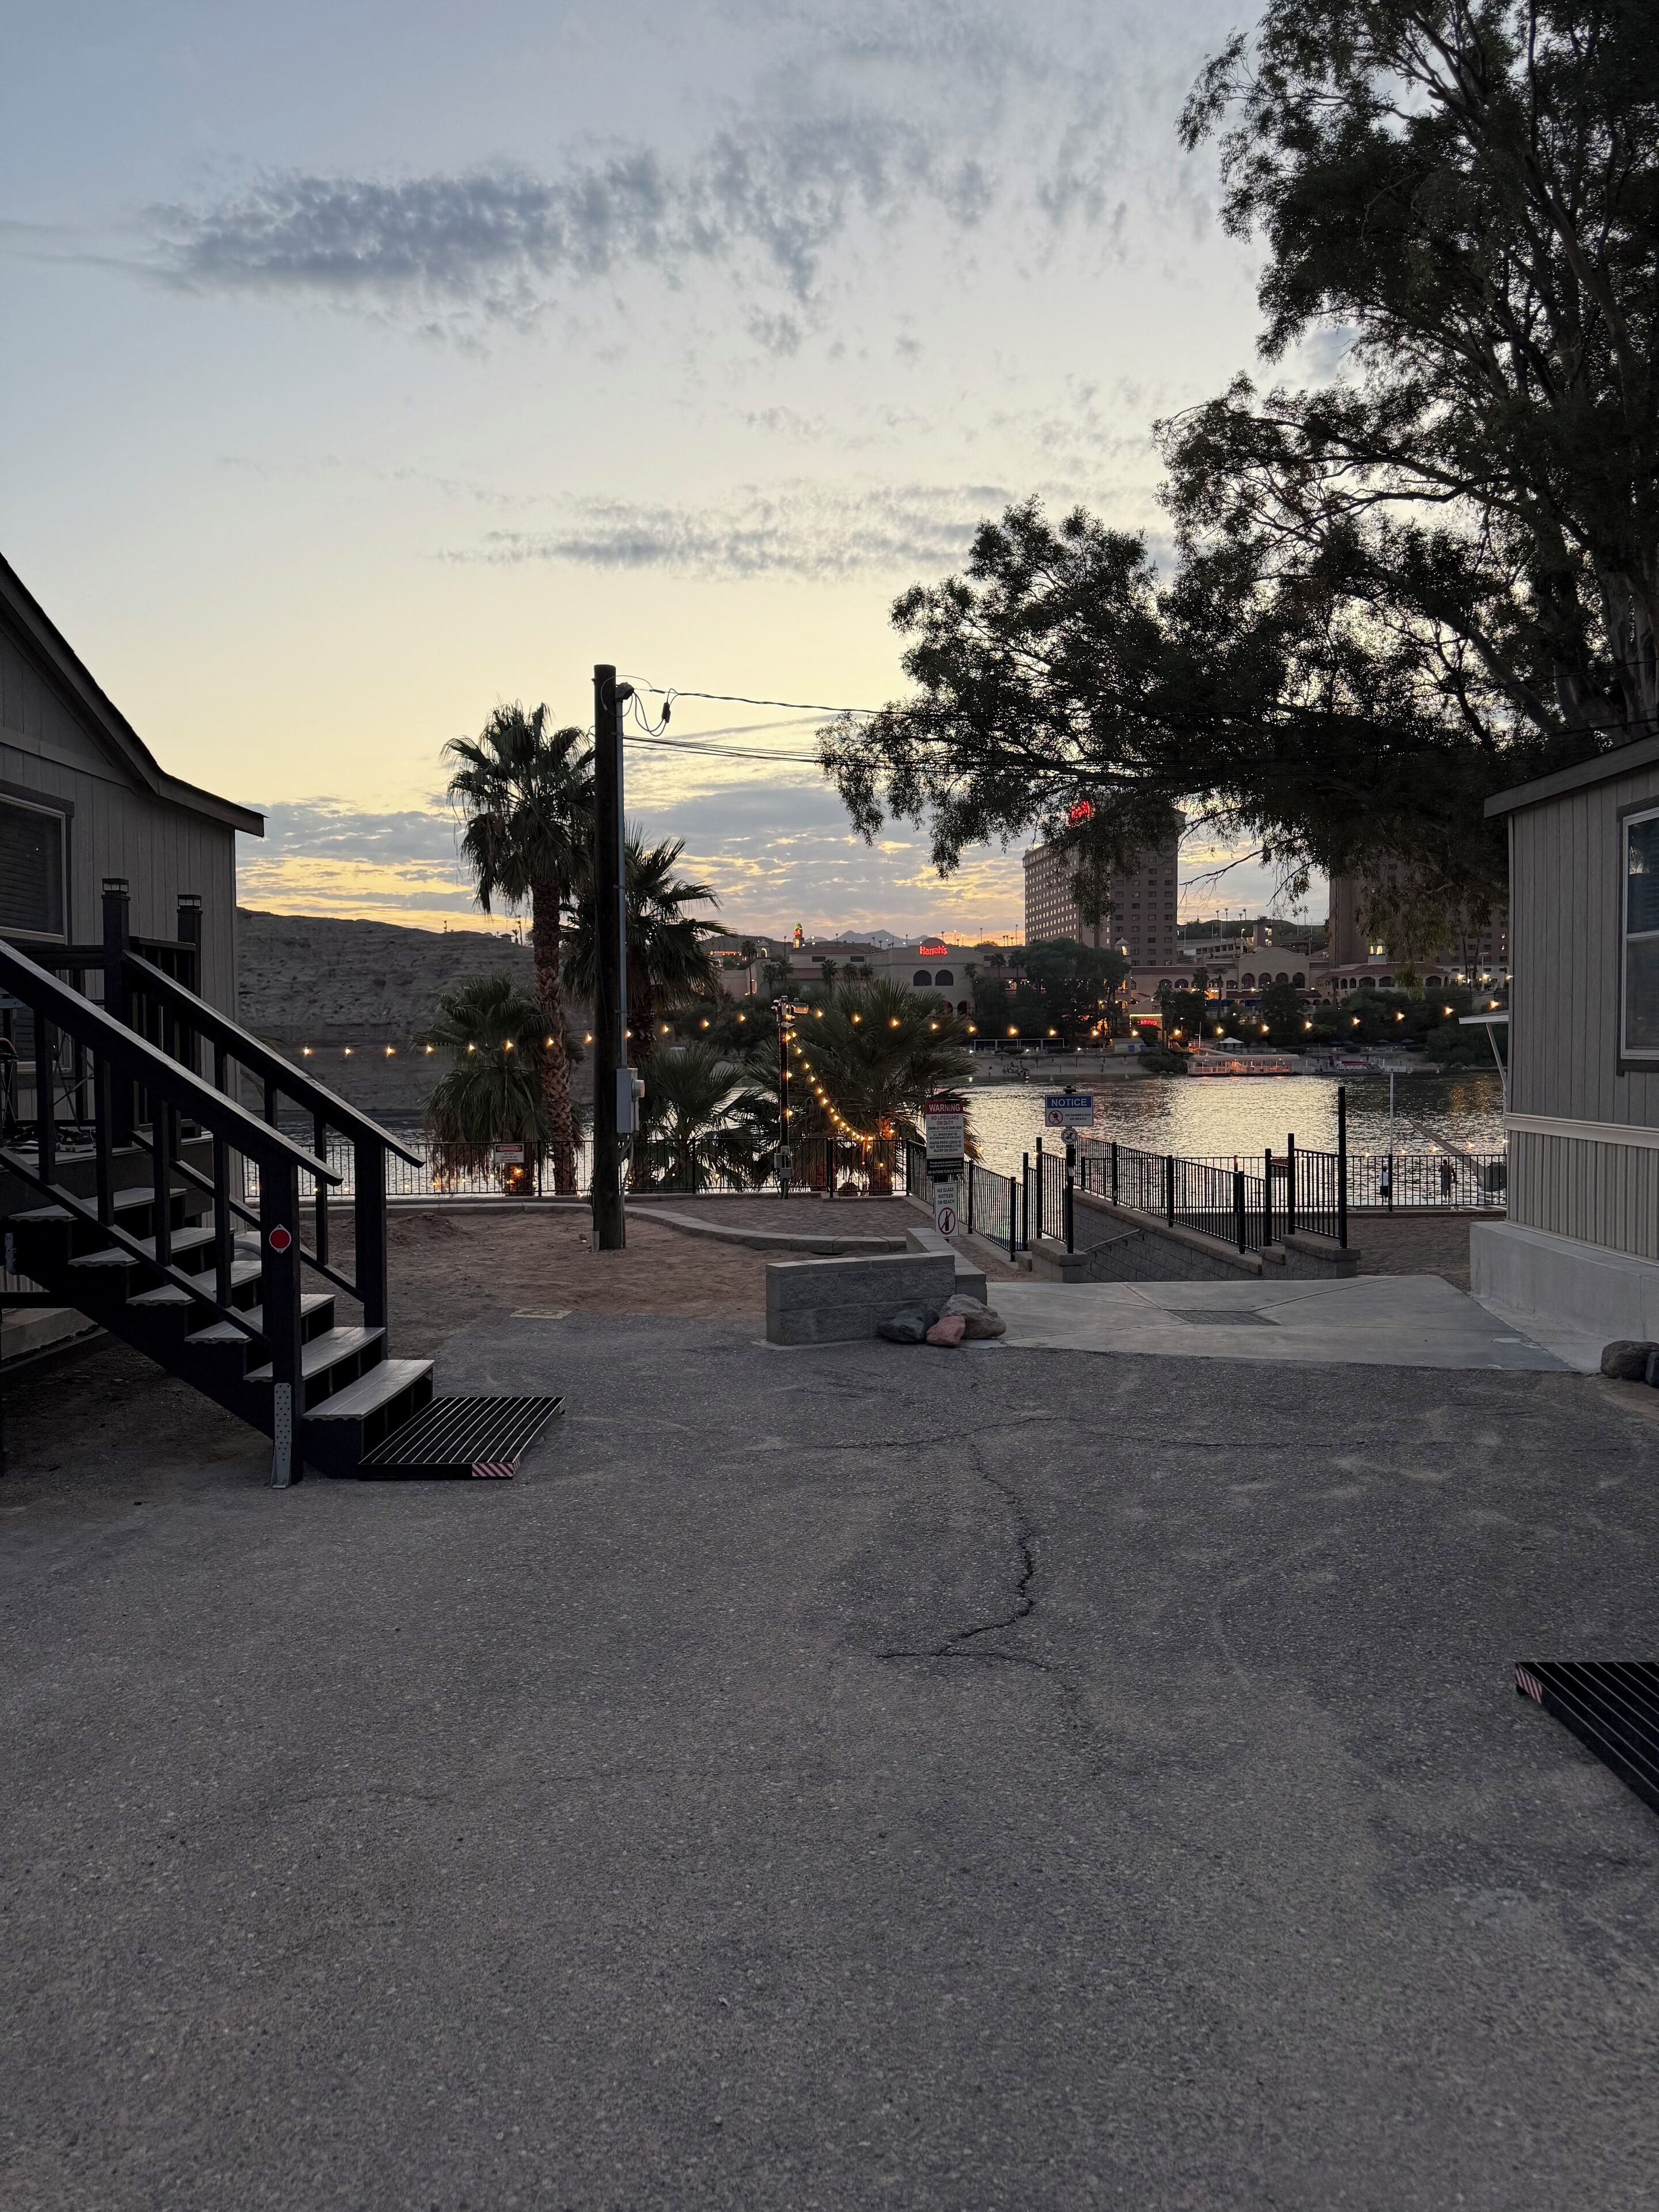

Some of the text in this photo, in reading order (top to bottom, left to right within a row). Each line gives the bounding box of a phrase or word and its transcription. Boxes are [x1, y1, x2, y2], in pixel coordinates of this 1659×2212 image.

[919, 945, 948, 955] Harrah's
[1051, 1098, 1087, 1107] NOTICE
[929, 1104, 960, 1112] WARNING
